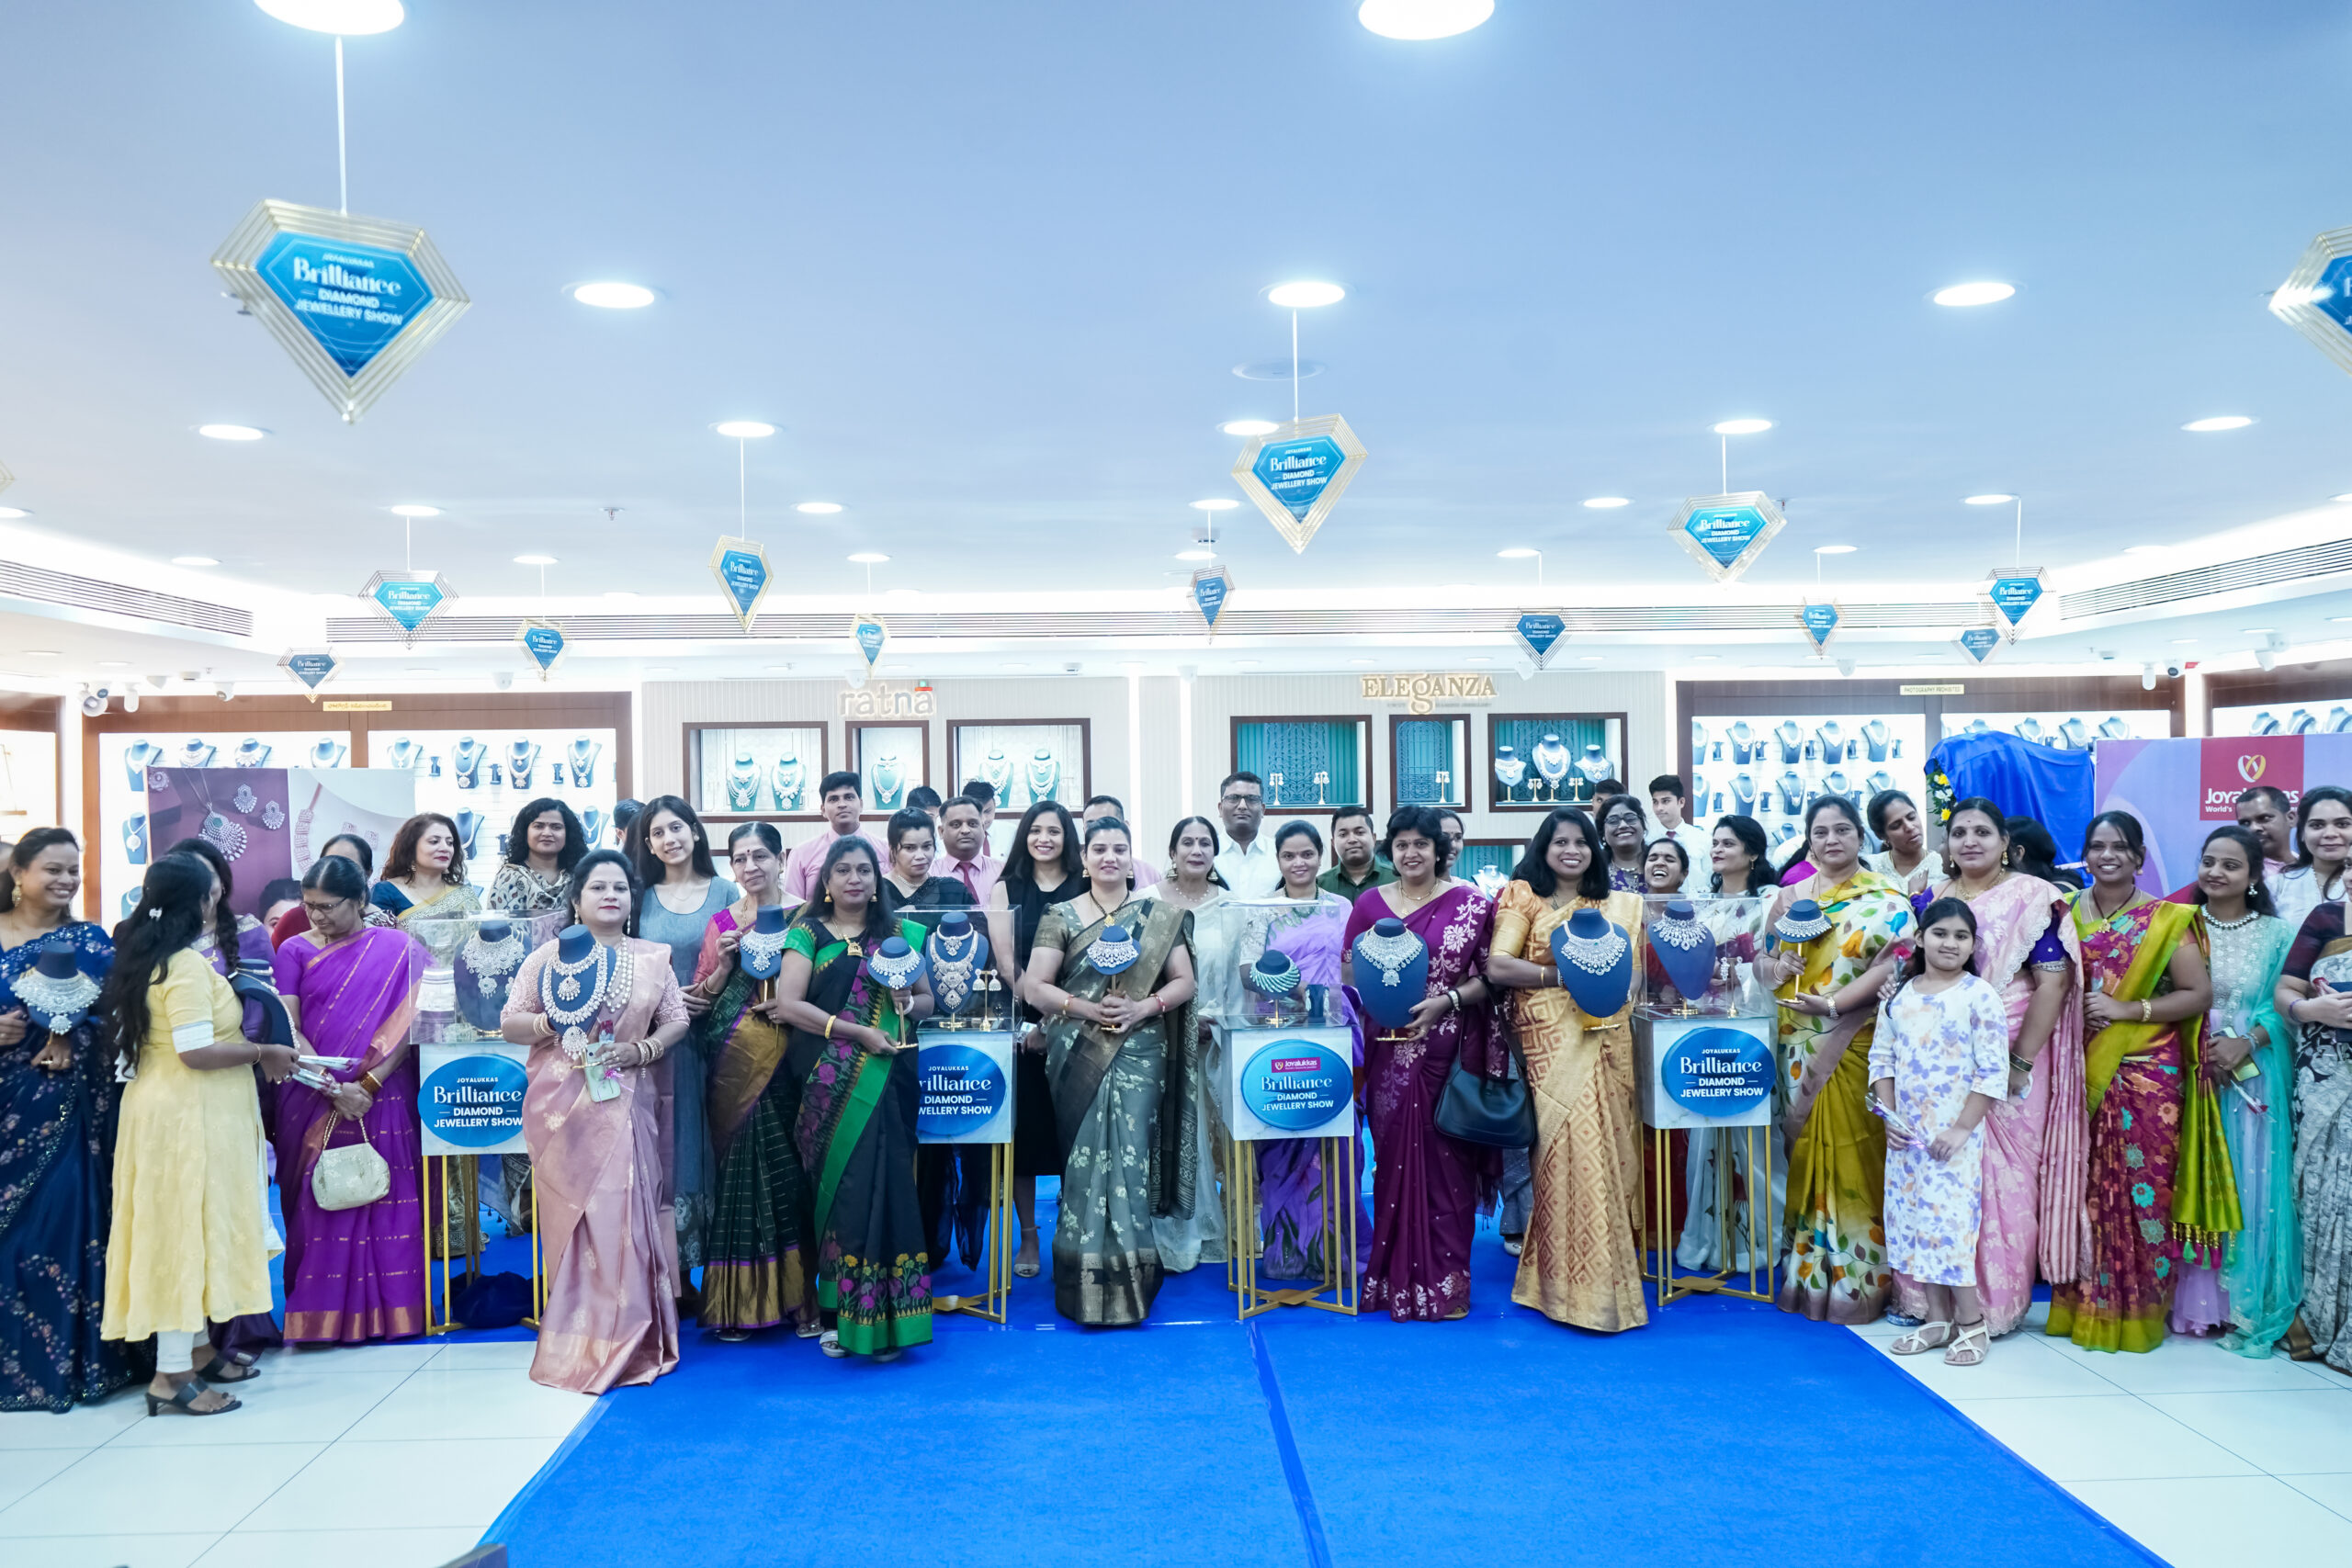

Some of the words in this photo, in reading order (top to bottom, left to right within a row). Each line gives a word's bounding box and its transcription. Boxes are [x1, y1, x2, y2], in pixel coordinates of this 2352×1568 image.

[293, 256, 401, 297] Brilliance
[318, 288, 380, 310] DIAMOND
[296, 299, 363, 320] JEWELLERY
[364, 309, 403, 326] SHOW
[1271, 455, 1327, 472] Brilliance
[1283, 469, 1315, 480] DIAMOND
[1271, 478, 1306, 490] JEWELLERY
[1306, 477, 1328, 486] SHOW
[1700, 518, 1750, 530] Brilliance
[730, 560, 759, 576] Brilliance
[388, 591, 430, 600] Brilliance
[1999, 587, 2033, 595] Brilliance
[297, 660, 327, 668] Brilliance
[840, 684, 933, 716] ratna
[1680, 1056, 1763, 1074] Brilliance
[919, 1075, 992, 1091] rilliance
[1261, 1076, 1333, 1091] Brilliance
[1699, 1077, 1745, 1087] DIAMOND
[434, 1086, 523, 1103] Brilliance
[1277, 1092, 1317, 1101] DIAMOND
[1680, 1088, 1732, 1098] JEWELLERY
[1734, 1088, 1764, 1096] SHOW
[924, 1095, 973, 1104] DIAMOND
[919, 1106, 958, 1115] WELLERY
[961, 1105, 992, 1115] SHOW
[1261, 1101, 1306, 1111] JEWELLERY
[1307, 1100, 1334, 1109] SHOW
[453, 1107, 503, 1116] DIAMOND
[434, 1118, 490, 1128] JEWELLERY
[491, 1117, 523, 1126] SHOW
